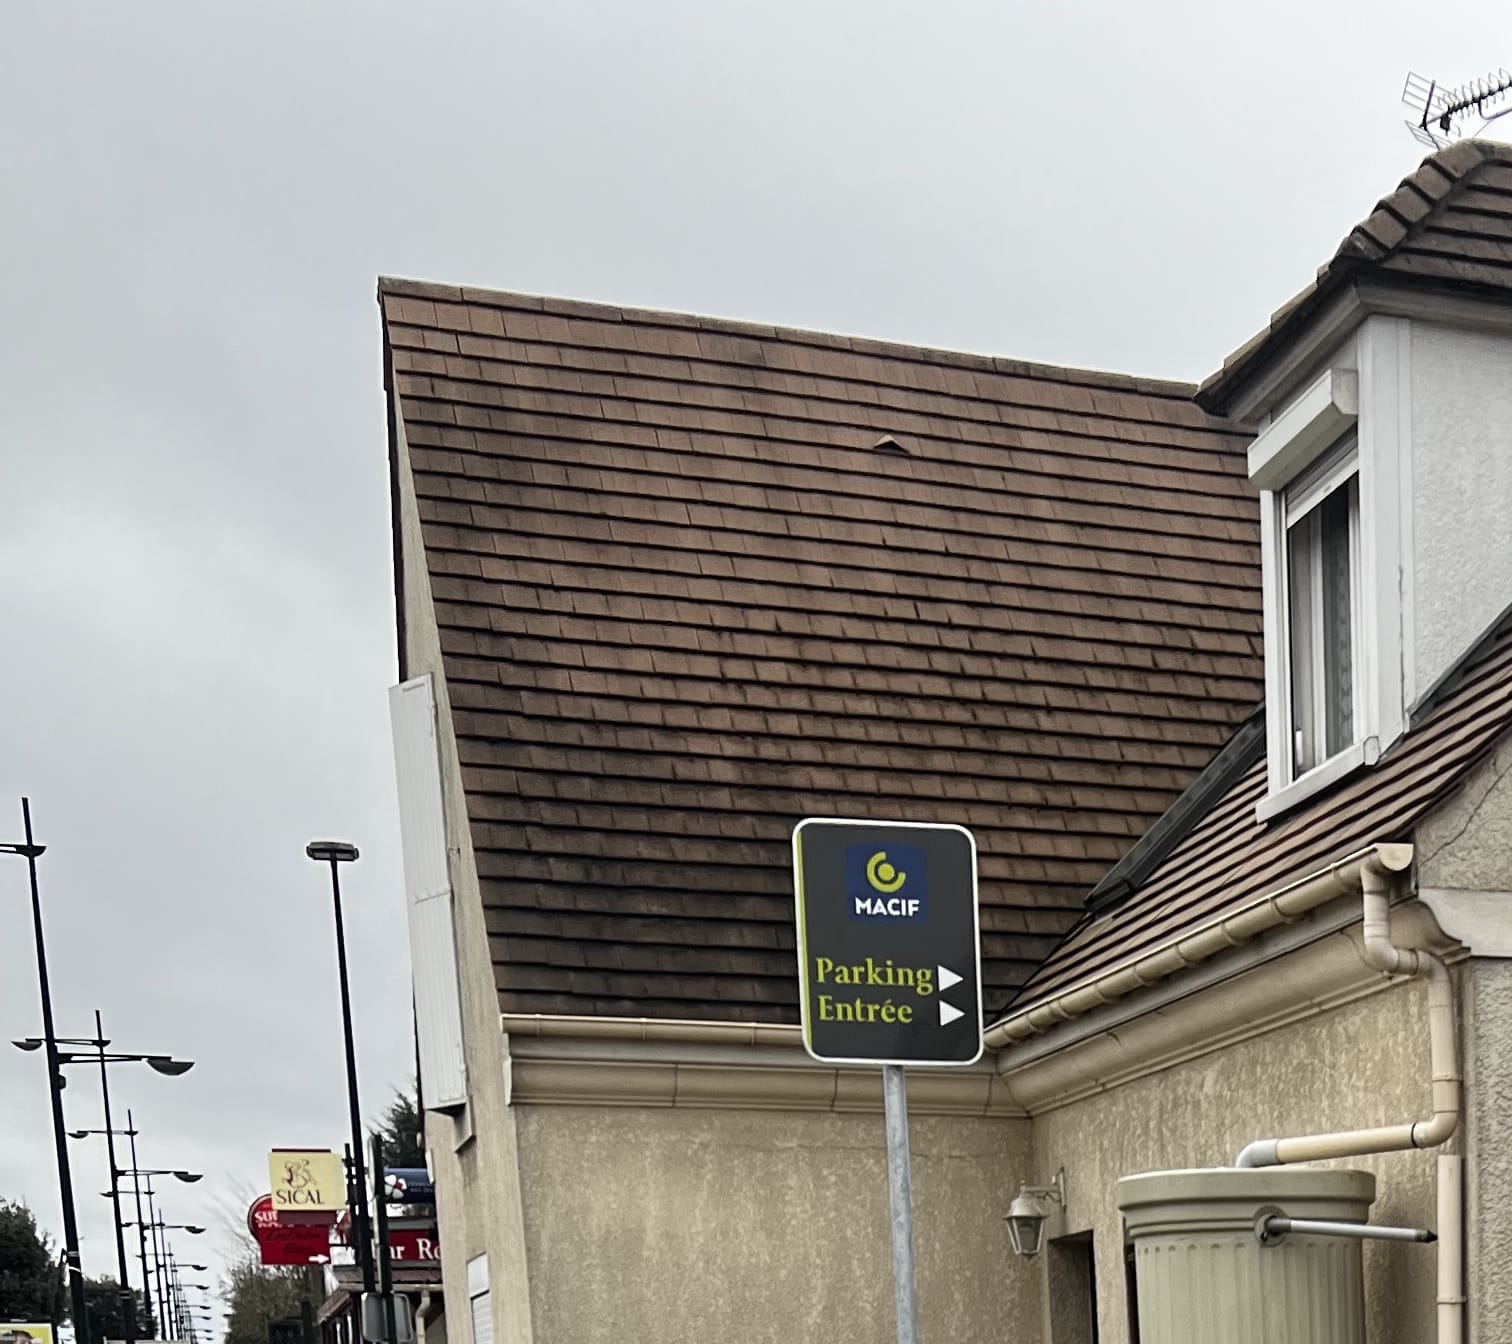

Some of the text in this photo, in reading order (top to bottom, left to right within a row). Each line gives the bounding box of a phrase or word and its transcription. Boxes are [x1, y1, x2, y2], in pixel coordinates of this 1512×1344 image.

[855, 897, 920, 917] MACIF
[815, 957, 934, 996] Parking
[817, 995, 913, 1024] Entrée
[275, 1189, 325, 1205] SICAL
